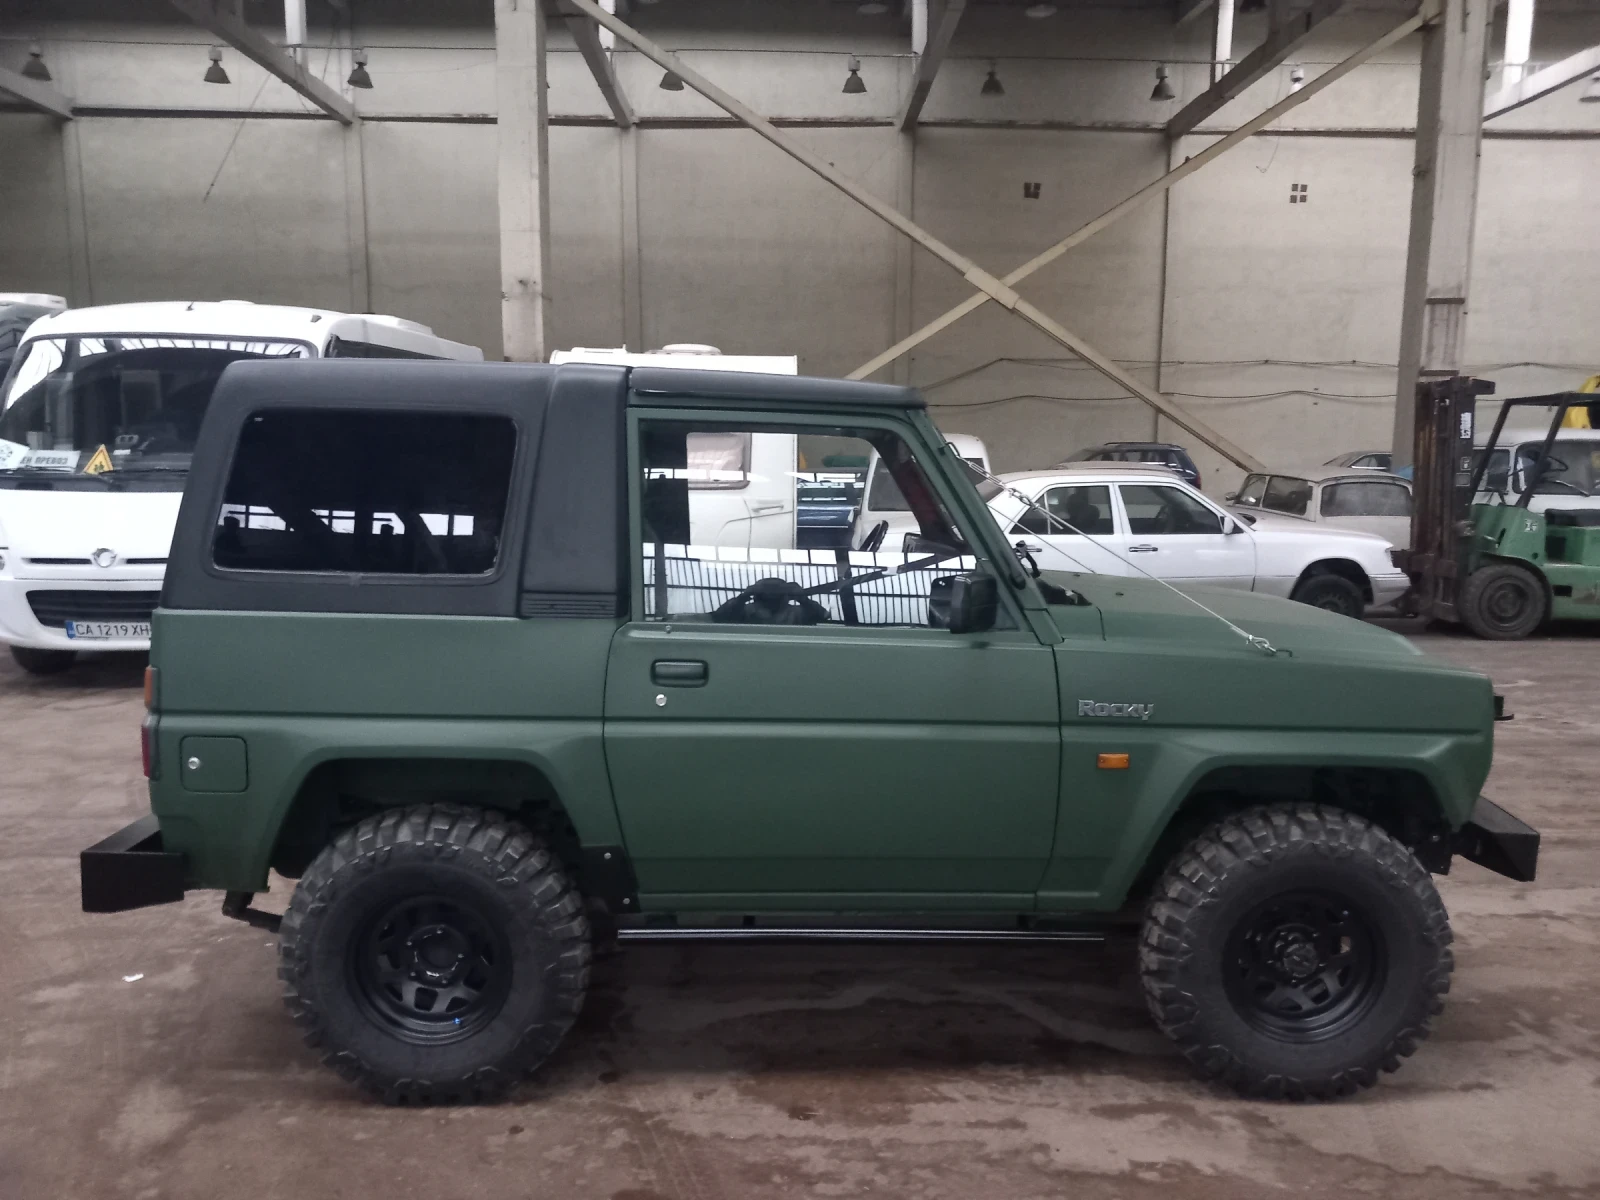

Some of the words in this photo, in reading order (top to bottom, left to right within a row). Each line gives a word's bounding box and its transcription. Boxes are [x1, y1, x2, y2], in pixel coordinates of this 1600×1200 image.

[75, 624, 94, 636] CA
[97, 624, 129, 636] 1219
[131, 624, 150, 636] XH
